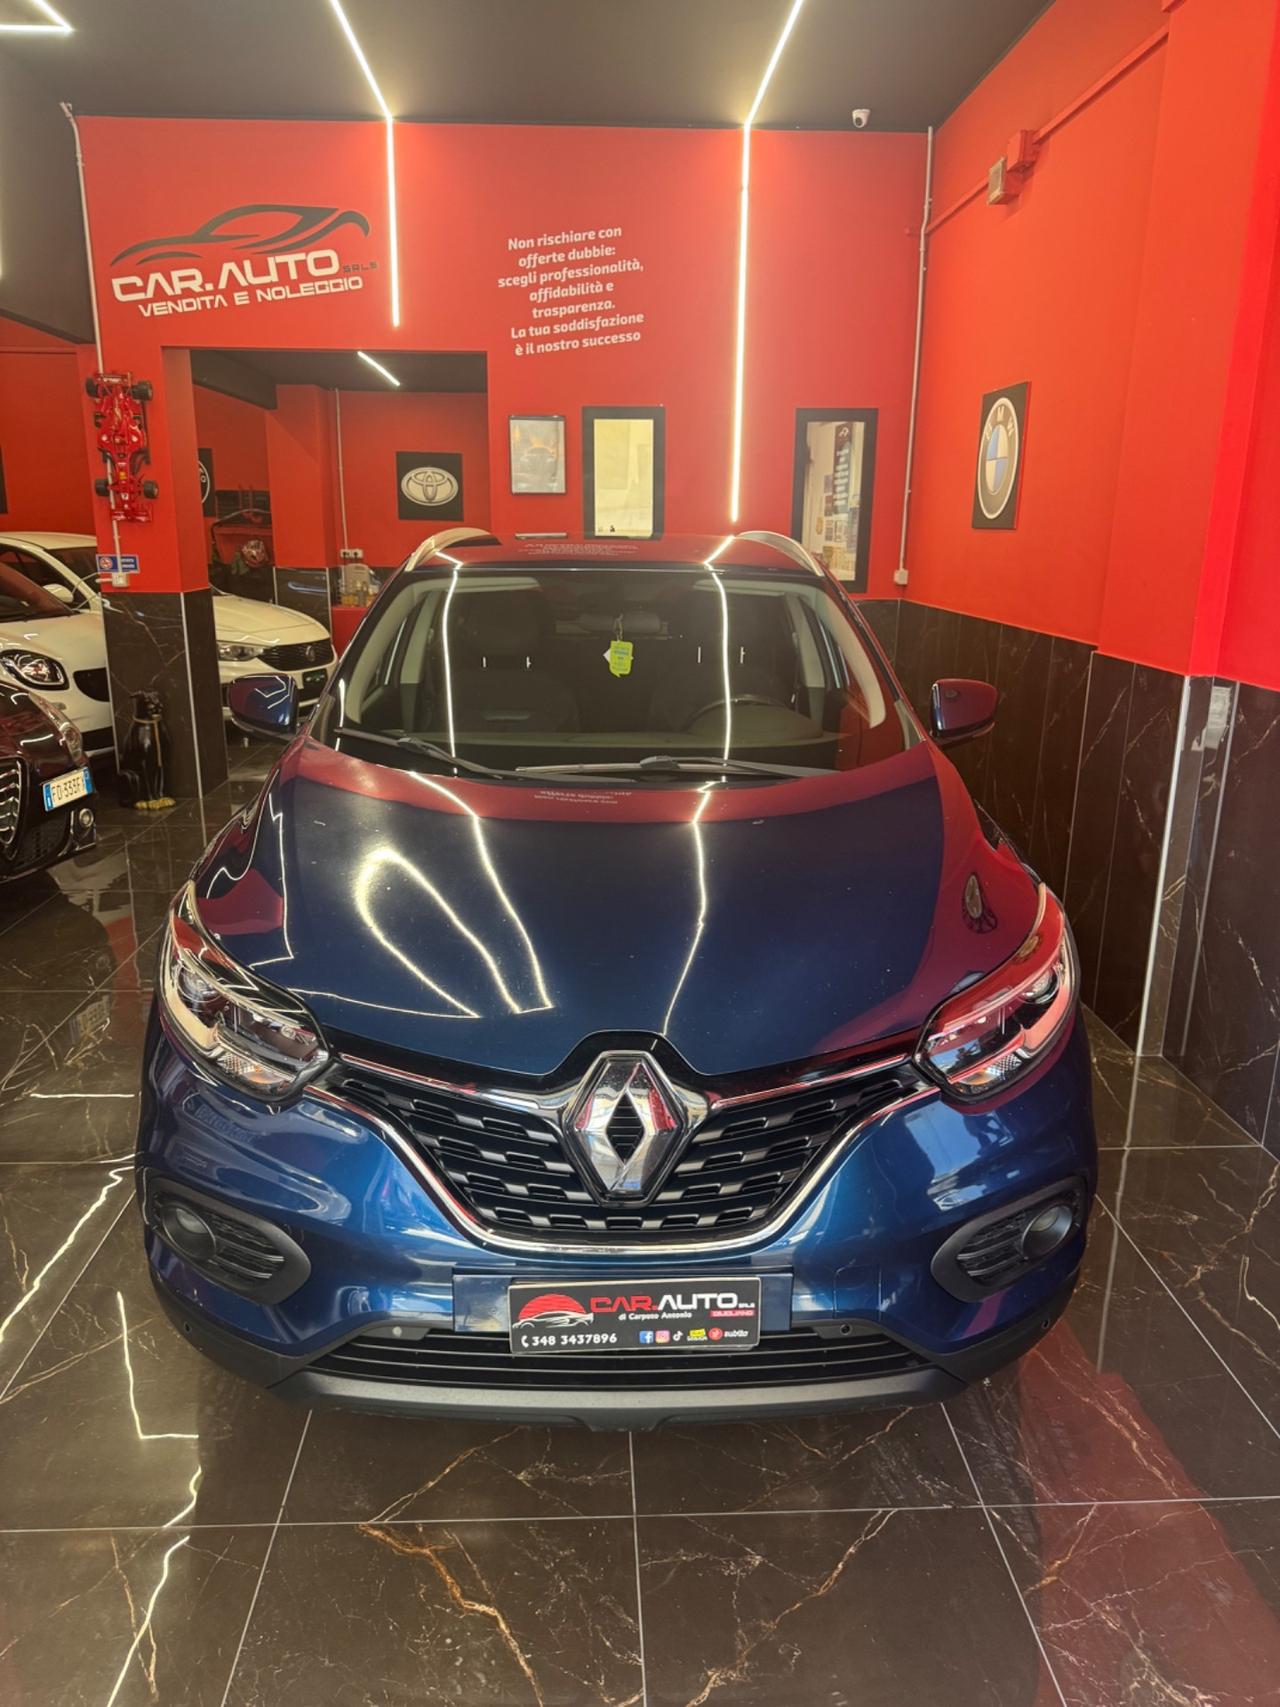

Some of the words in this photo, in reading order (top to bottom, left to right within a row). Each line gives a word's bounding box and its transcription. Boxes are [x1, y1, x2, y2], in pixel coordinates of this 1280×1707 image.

[508, 238, 535, 251] Non
[537, 230, 596, 247] rischiare
[598, 226, 622, 239] con
[518, 253, 565, 268] offerte
[568, 245, 616, 260] dubbie:
[111, 249, 340, 302] CAR.AUTO
[497, 271, 538, 288] scegli
[539, 259, 643, 284] professionalità,
[138, 294, 228, 318] VENDITA
[234, 291, 251, 306] E
[256, 275, 364, 303] NOLEGGIO
[529, 282, 603, 303] affidabilità
[605, 281, 615, 292] e
[532, 300, 615, 318] trasparenza.
[511, 326, 527, 339] La
[528, 325, 551, 338] tua
[552, 313, 645, 332] soddisfazione
[514, 345, 524, 357] è
[525, 342, 535, 355] il
[536, 336, 580, 354] nostro
[581, 331, 642, 347] successo
[590, 1292, 738, 1313] CAR.AUTO
[532, 1334, 557, 1347] 348
[560, 1332, 618, 1346] 3437896
